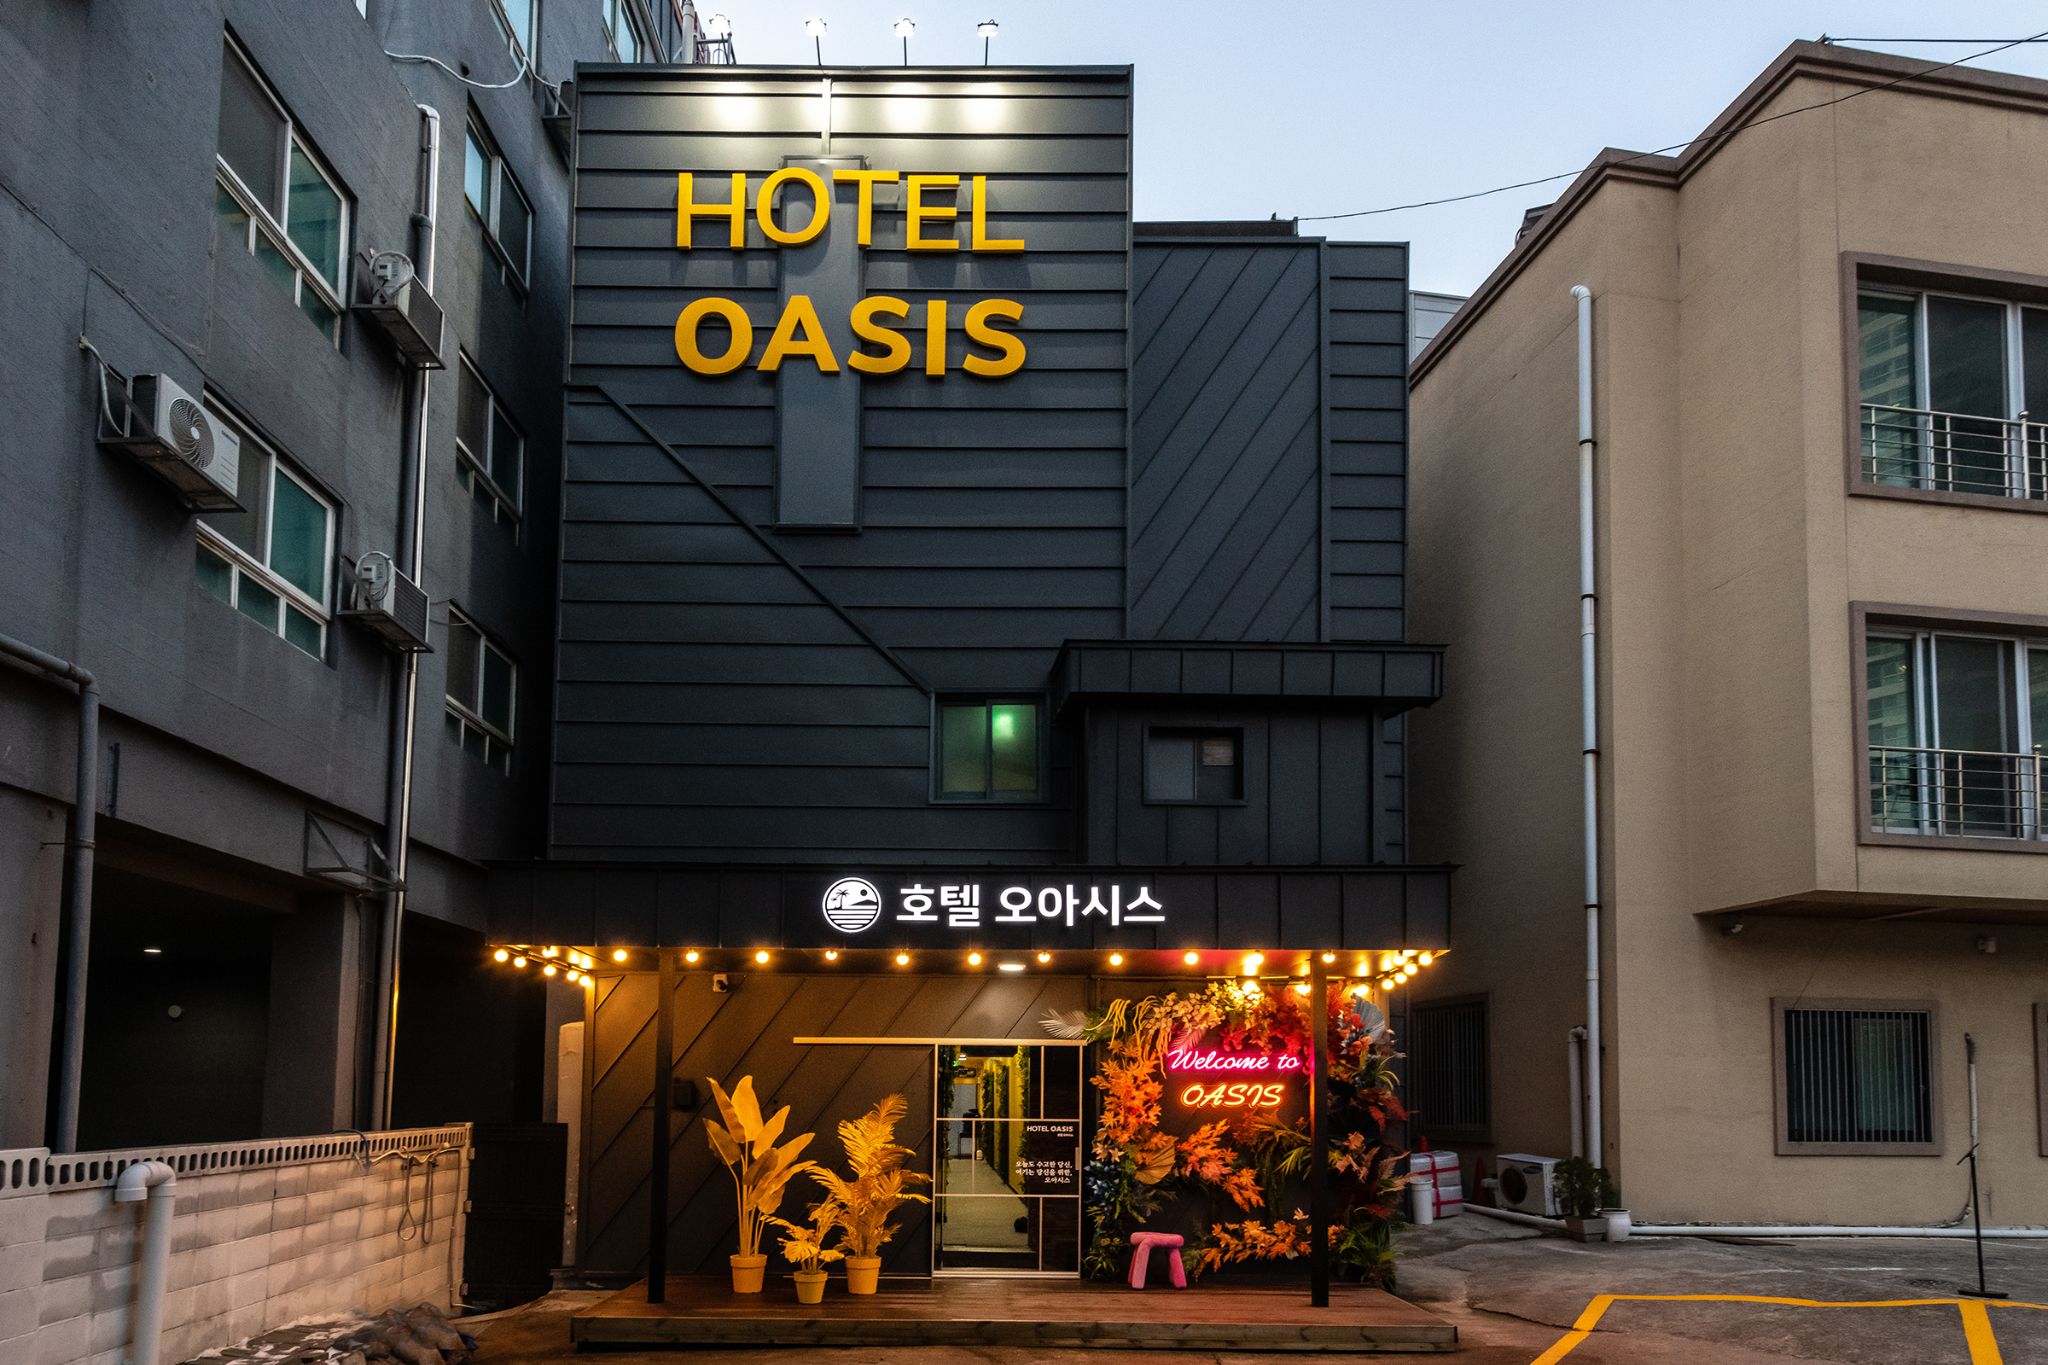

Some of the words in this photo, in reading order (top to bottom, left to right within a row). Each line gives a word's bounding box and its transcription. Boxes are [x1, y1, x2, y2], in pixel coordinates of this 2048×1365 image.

[676, 167, 1025, 253] HOTEL
[674, 295, 1027, 377] OASIS
[896, 884, 980, 927] 호텔
[995, 884, 1166, 927] 오아시스
[1167, 1050, 1270, 1070] Welcome
[1277, 1053, 1300, 1070] to
[1181, 1083, 1285, 1108] OASIS
